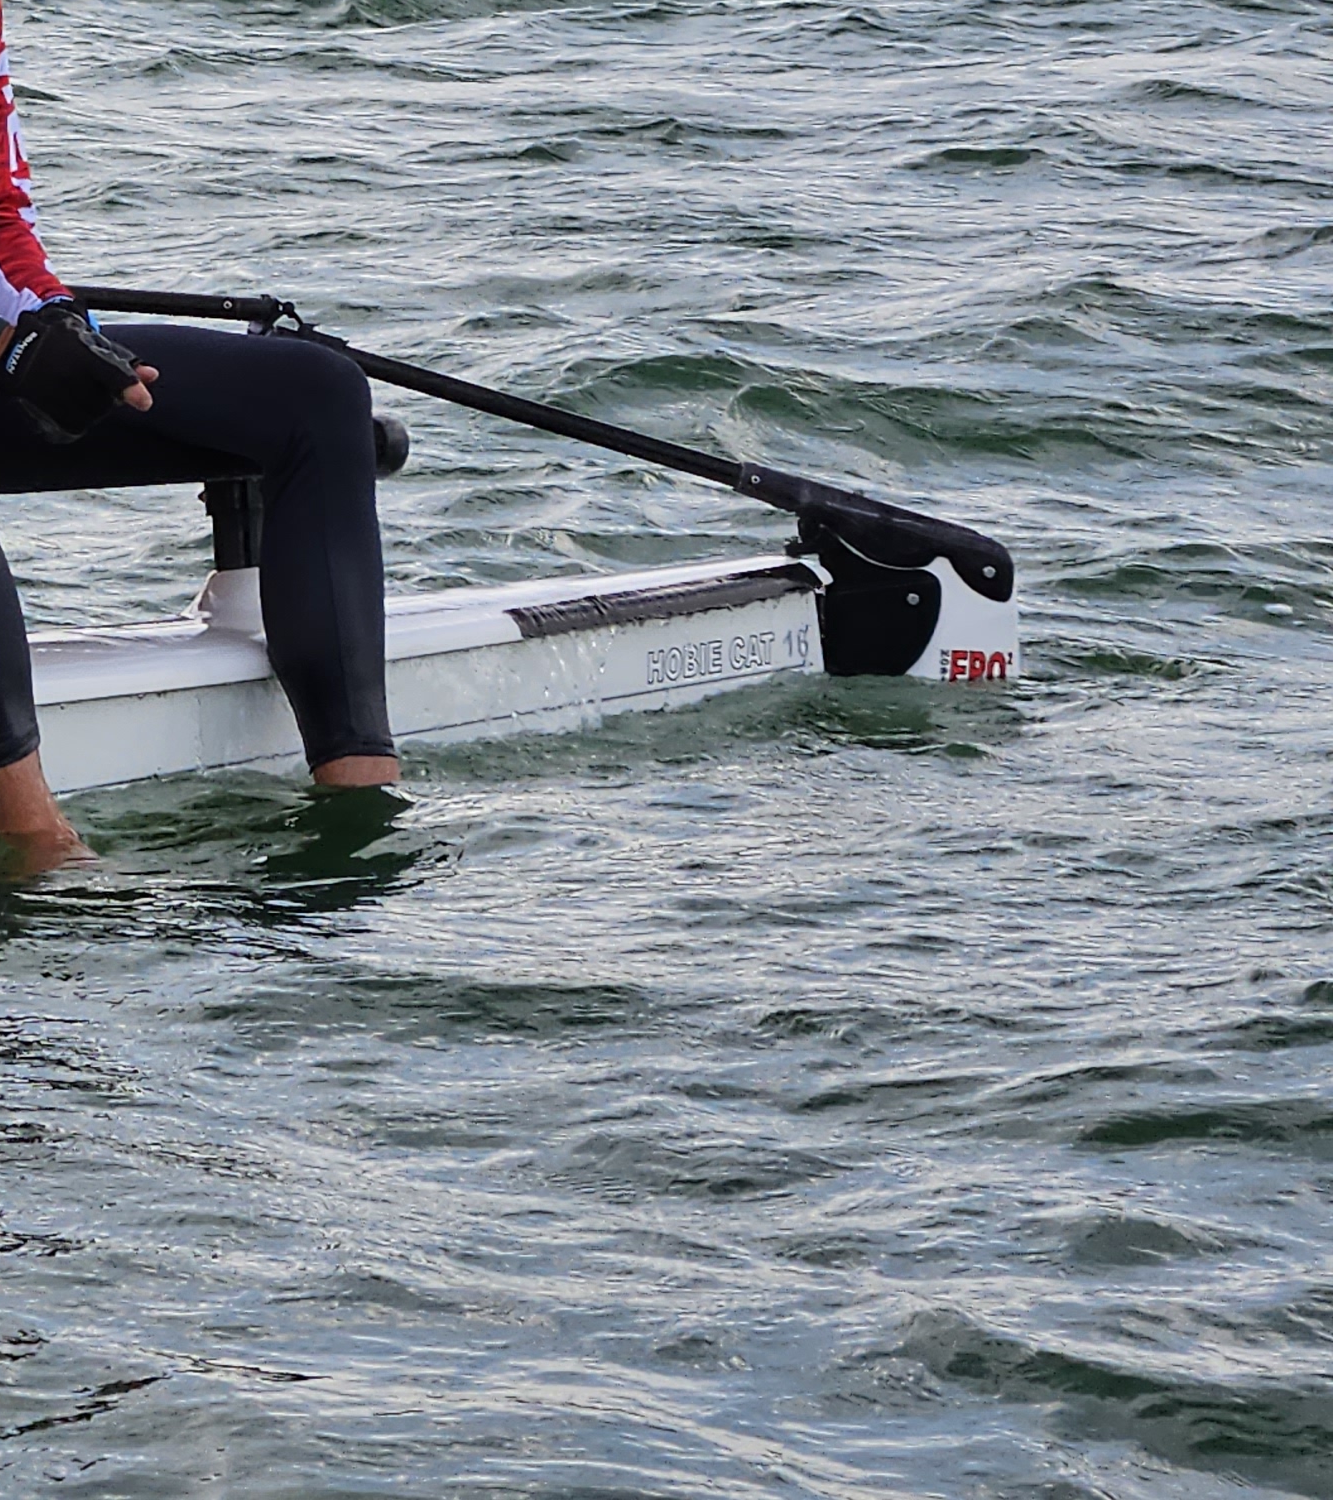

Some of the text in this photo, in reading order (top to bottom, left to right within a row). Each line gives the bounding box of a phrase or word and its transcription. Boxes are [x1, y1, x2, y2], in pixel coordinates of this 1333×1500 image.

[647, 624, 811, 684] HOBIE CAT 16
